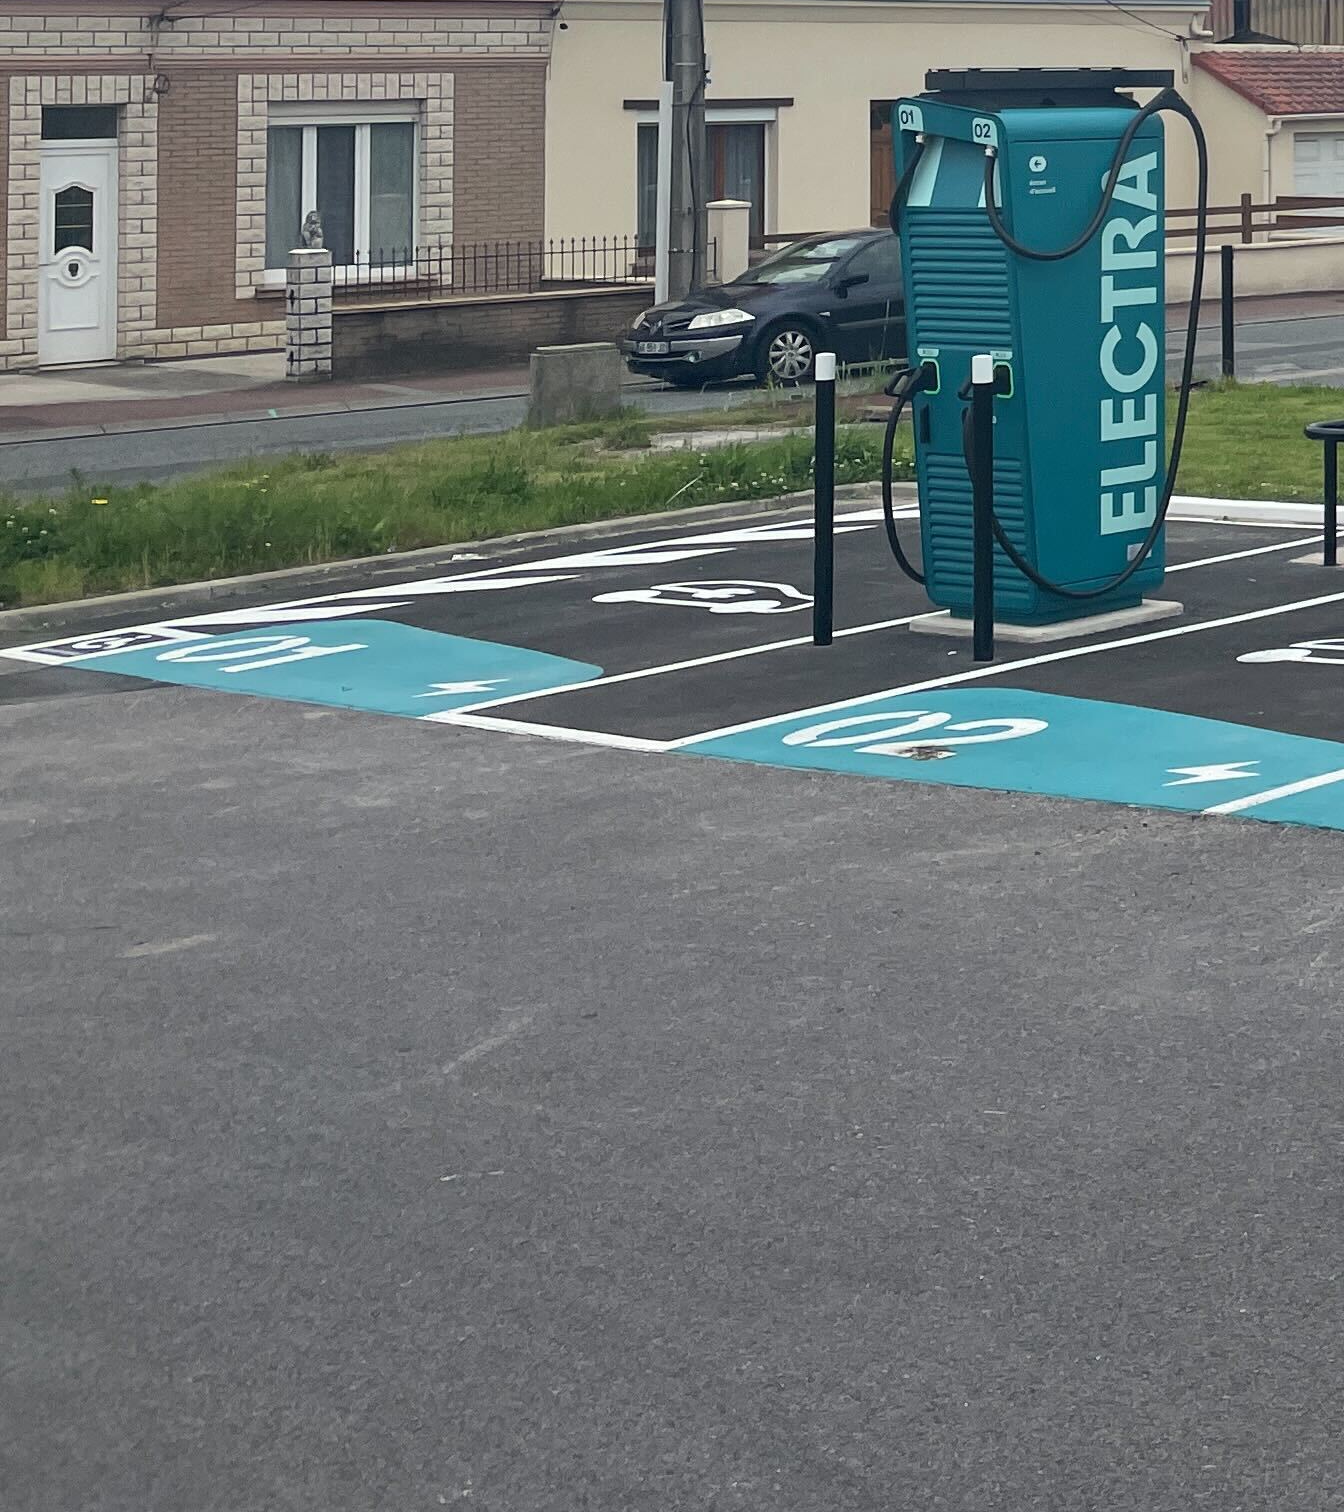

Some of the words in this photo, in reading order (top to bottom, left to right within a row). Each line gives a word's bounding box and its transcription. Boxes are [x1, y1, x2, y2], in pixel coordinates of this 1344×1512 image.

[900, 110, 914, 125] 01
[974, 124, 991, 139] 02
[1100, 151, 1158, 536] ELECTRA
[156, 634, 369, 673] 01
[782, 710, 1049, 761] 02
